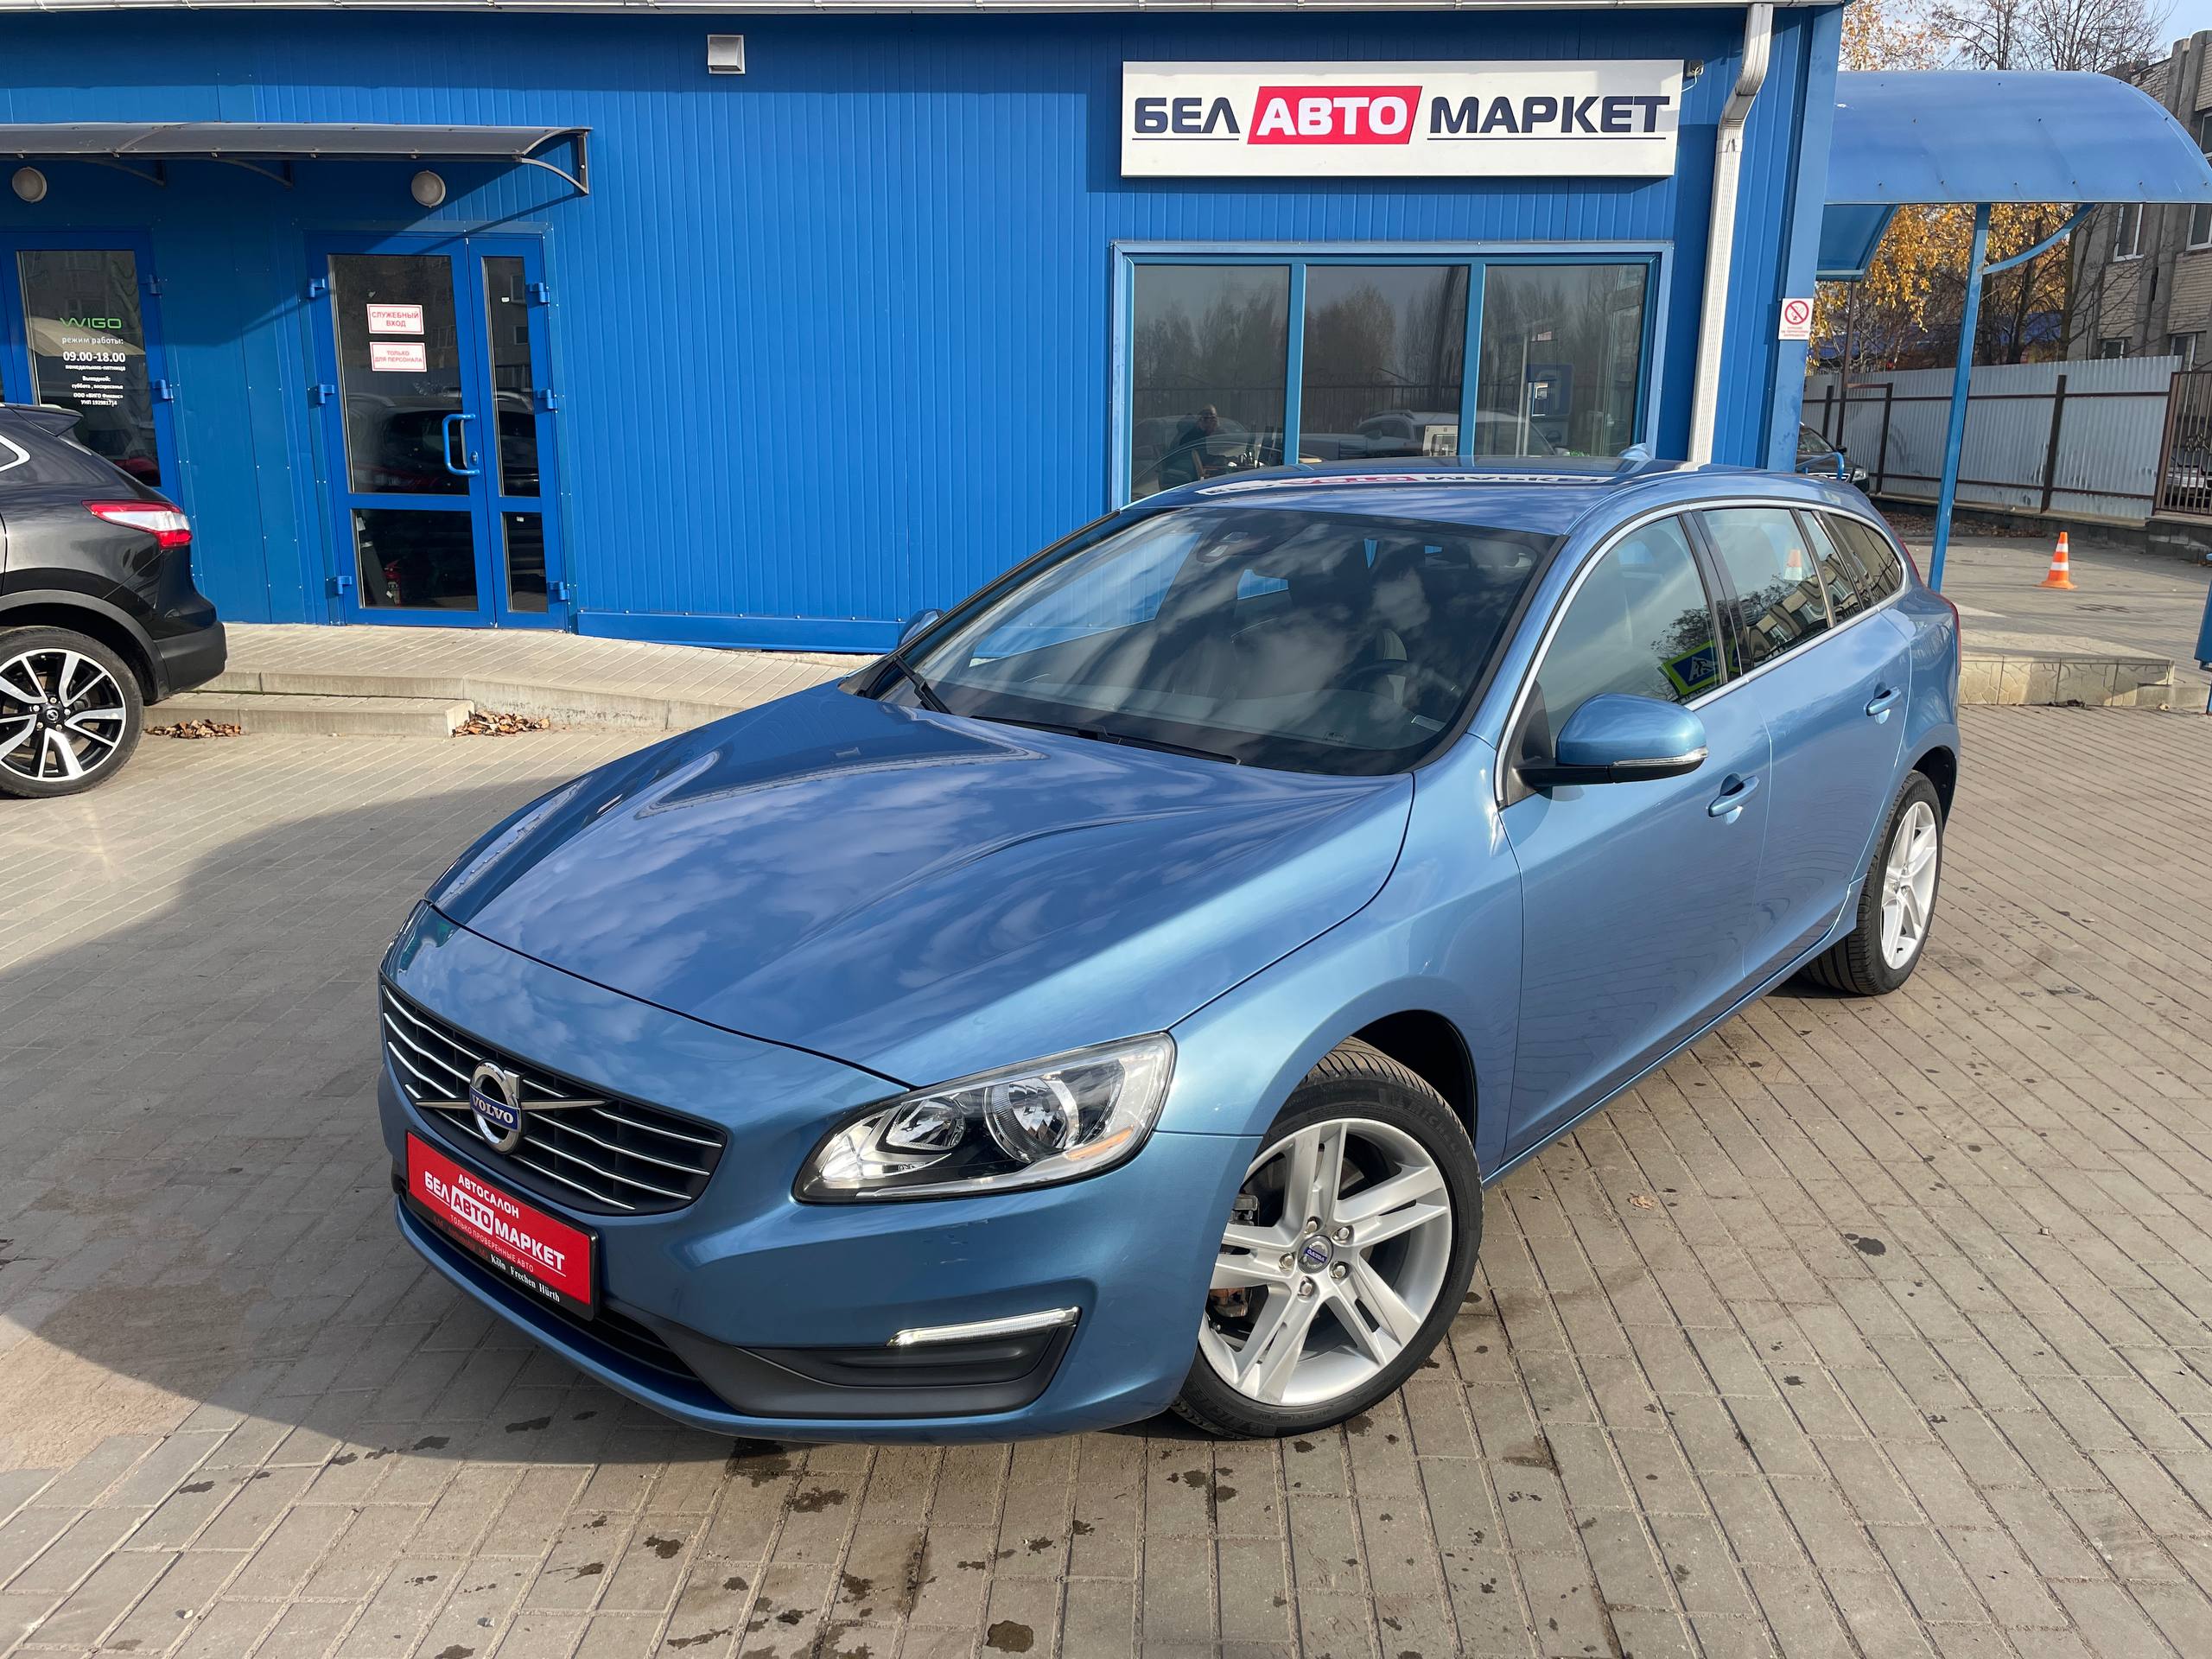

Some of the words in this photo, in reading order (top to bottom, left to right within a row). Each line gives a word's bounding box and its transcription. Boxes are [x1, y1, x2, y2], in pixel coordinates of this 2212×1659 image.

[1135, 96, 1241, 134] БЕЛ
[1255, 95, 1409, 136] АВТО
[1429, 95, 1671, 134] МАРКЕТ
[60, 317, 122, 328] WIGO
[92, 336, 124, 345] работы:
[62, 351, 126, 362] 09.00-18.00
[471, 1095, 514, 1124] VOLVO
[458, 1173, 519, 1219] АВТОСАЛОН
[424, 1171, 450, 1203] БЕЛ
[454, 1192, 492, 1229] АВТО
[494, 1217, 565, 1271] МАРКЕТ
[490, 1254, 506, 1271] Köln
[517, 1258, 534, 1273] АВТО
